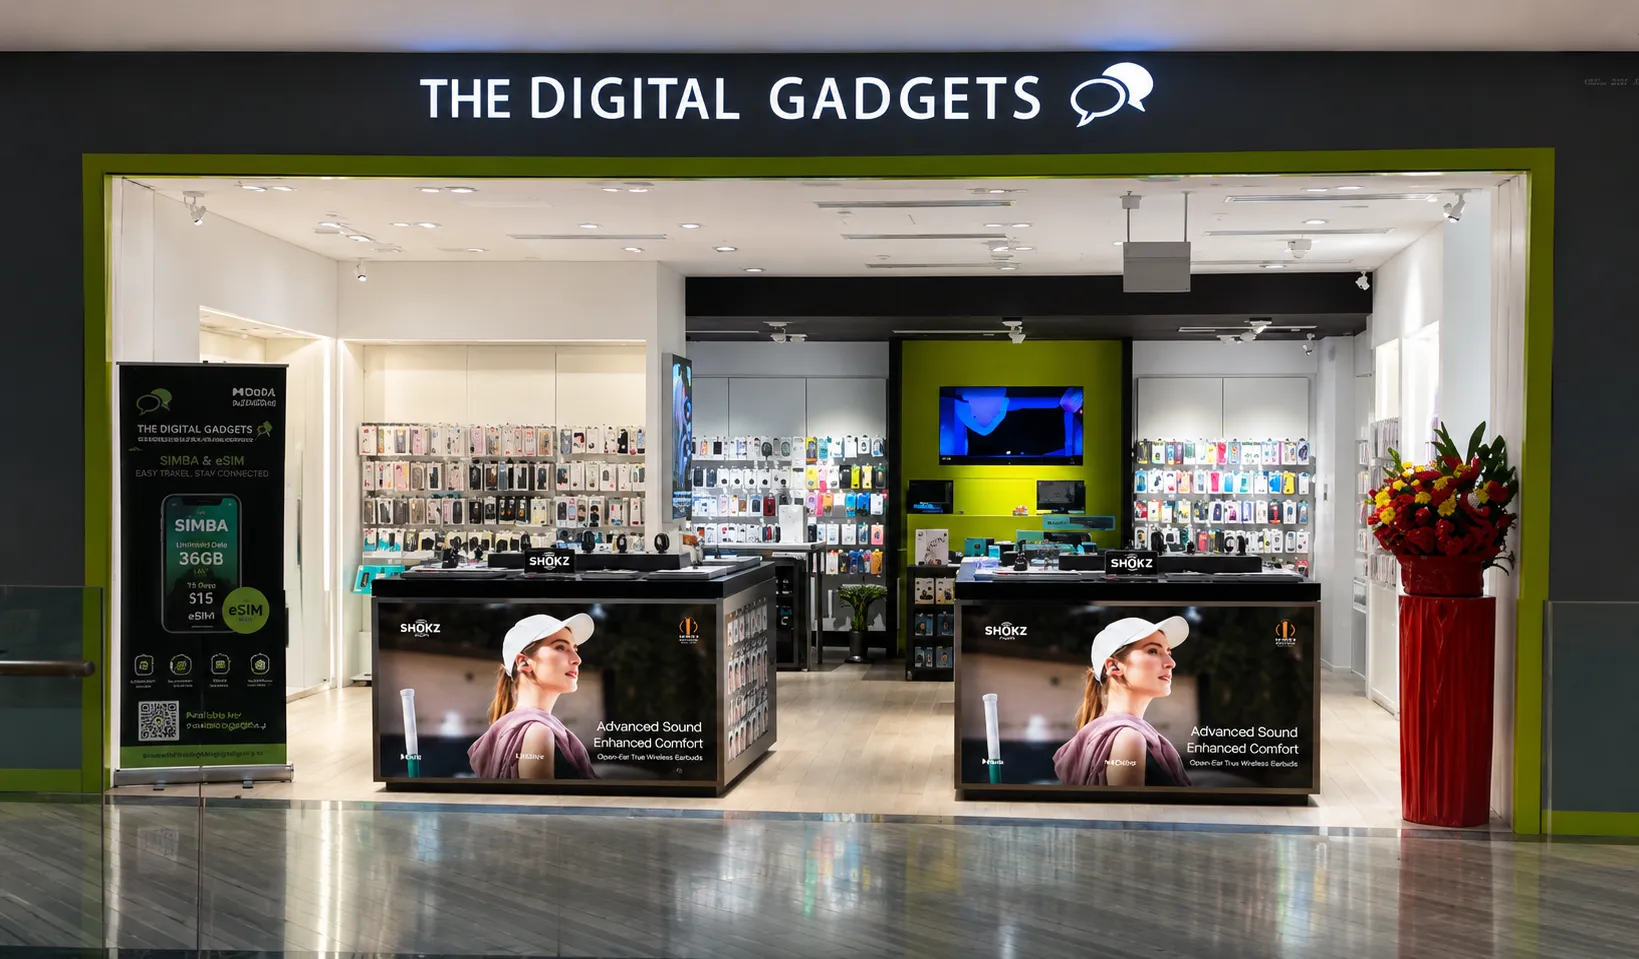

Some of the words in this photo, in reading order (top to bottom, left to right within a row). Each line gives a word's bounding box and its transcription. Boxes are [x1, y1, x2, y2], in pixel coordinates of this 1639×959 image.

[420, 78, 511, 119] THE
[531, 75, 740, 120] DIGITAL
[769, 75, 1041, 120] GADGETS
[137, 424, 158, 434] THE
[160, 424, 202, 434] DIGITAL
[204, 424, 253, 434] GADGETS
[160, 455, 200, 466] SIMBA
[202, 455, 212, 466] &
[215, 455, 245, 466] eSIM
[135, 469, 158, 478] EASY
[174, 518, 229, 532] SIMBA
[179, 551, 224, 566] 36GB
[529, 556, 570, 567] SHOKZ
[1110, 558, 1153, 569] SHOKZ
[189, 591, 214, 605] $15
[228, 604, 263, 617] eSIM
[400, 623, 441, 633] SHOKZ
[984, 626, 1028, 637] SHOKZ
[596, 721, 659, 733] Advanced
[662, 721, 703, 733] Sound
[1190, 725, 1255, 738] Advanced
[1257, 726, 1299, 739] Sound
[593, 737, 652, 749] Enhanced
[654, 737, 704, 749] Comfort
[1186, 742, 1247, 754] Enhanced
[1249, 742, 1300, 755] Comfort
